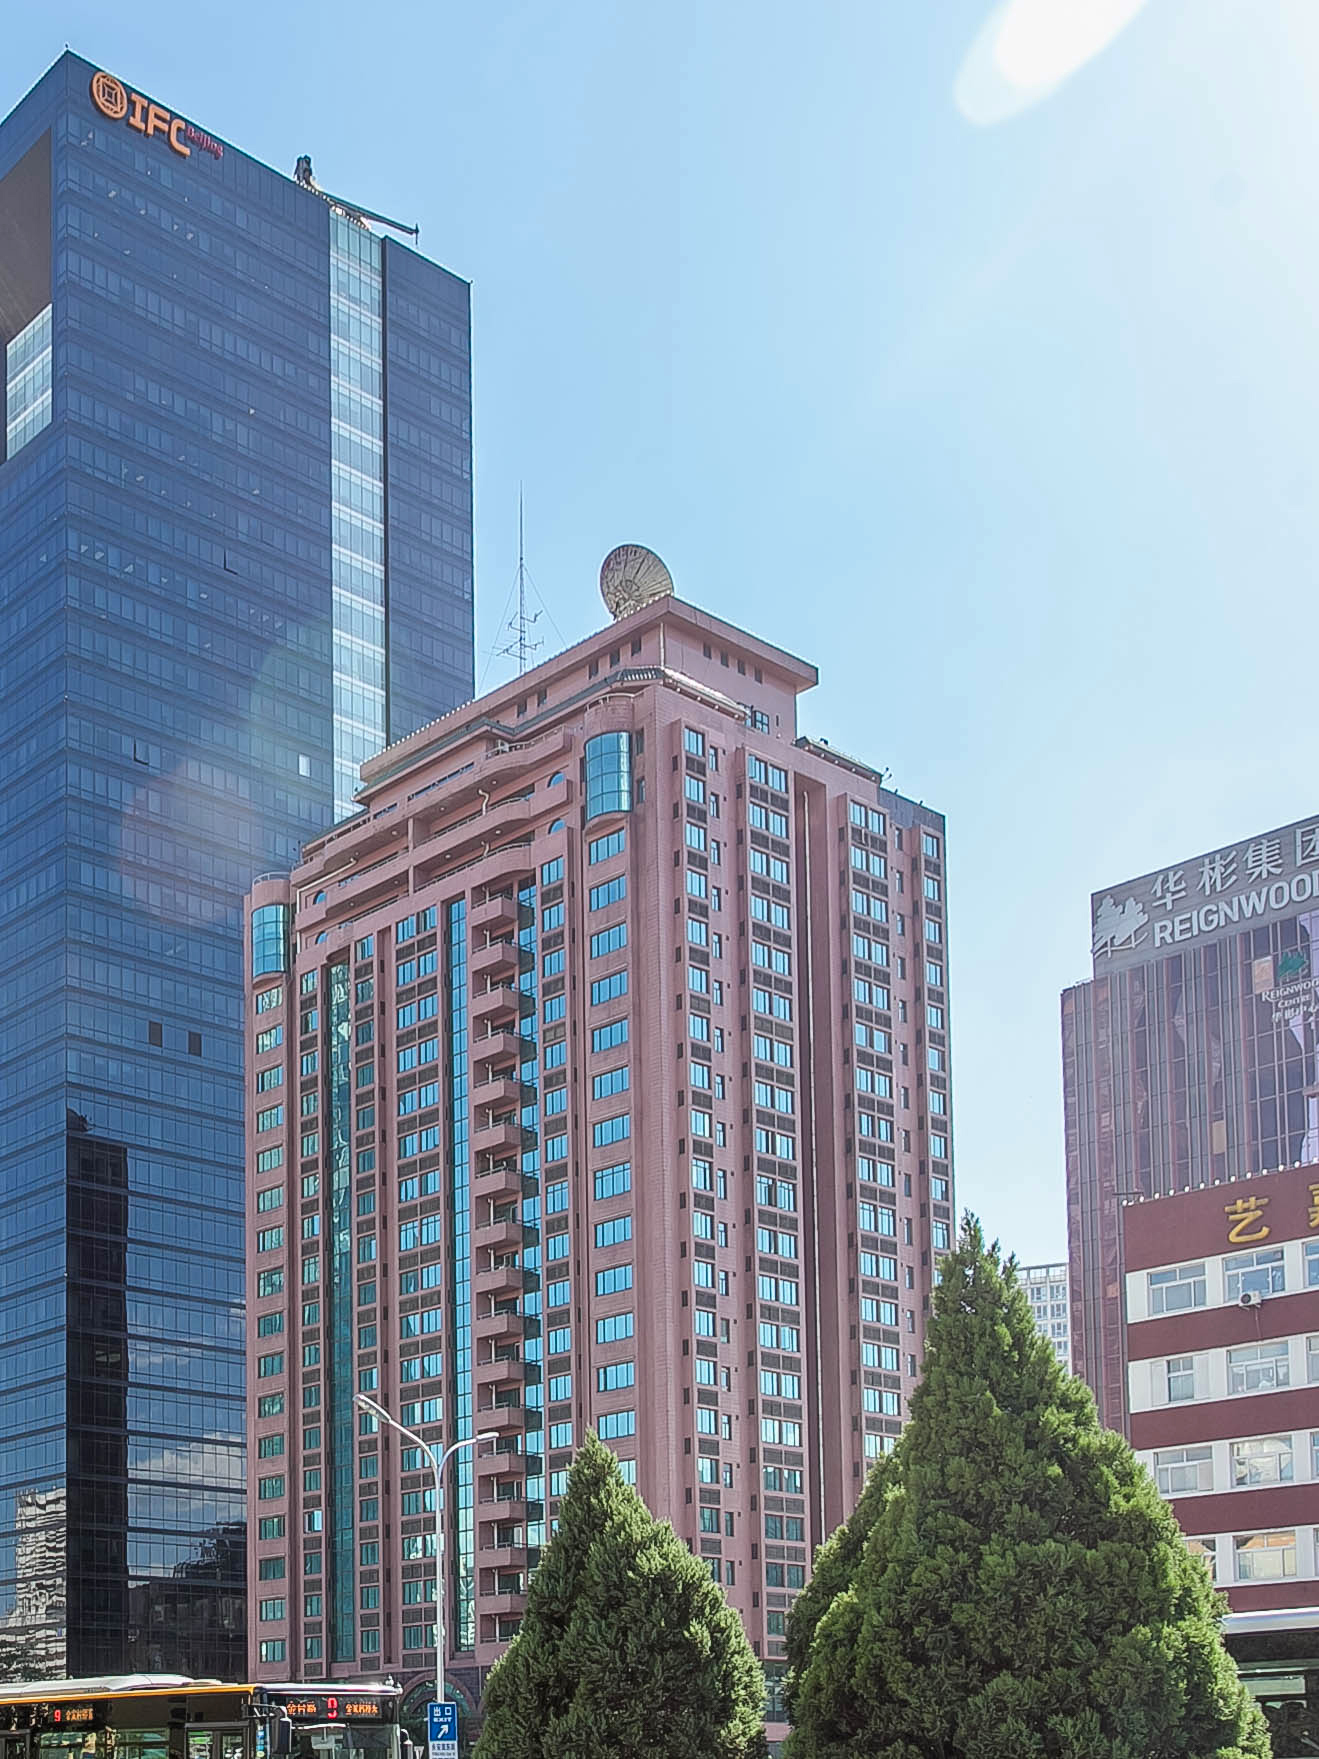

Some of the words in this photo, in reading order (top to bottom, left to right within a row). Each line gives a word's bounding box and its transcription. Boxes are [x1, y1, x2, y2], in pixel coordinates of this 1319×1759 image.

[129, 92, 191, 157] IFC
[1150, 824, 1319, 912] 华彬集团
[54, 1709, 61, 1722] 9
[433, 1706, 452, 1716] 出口
